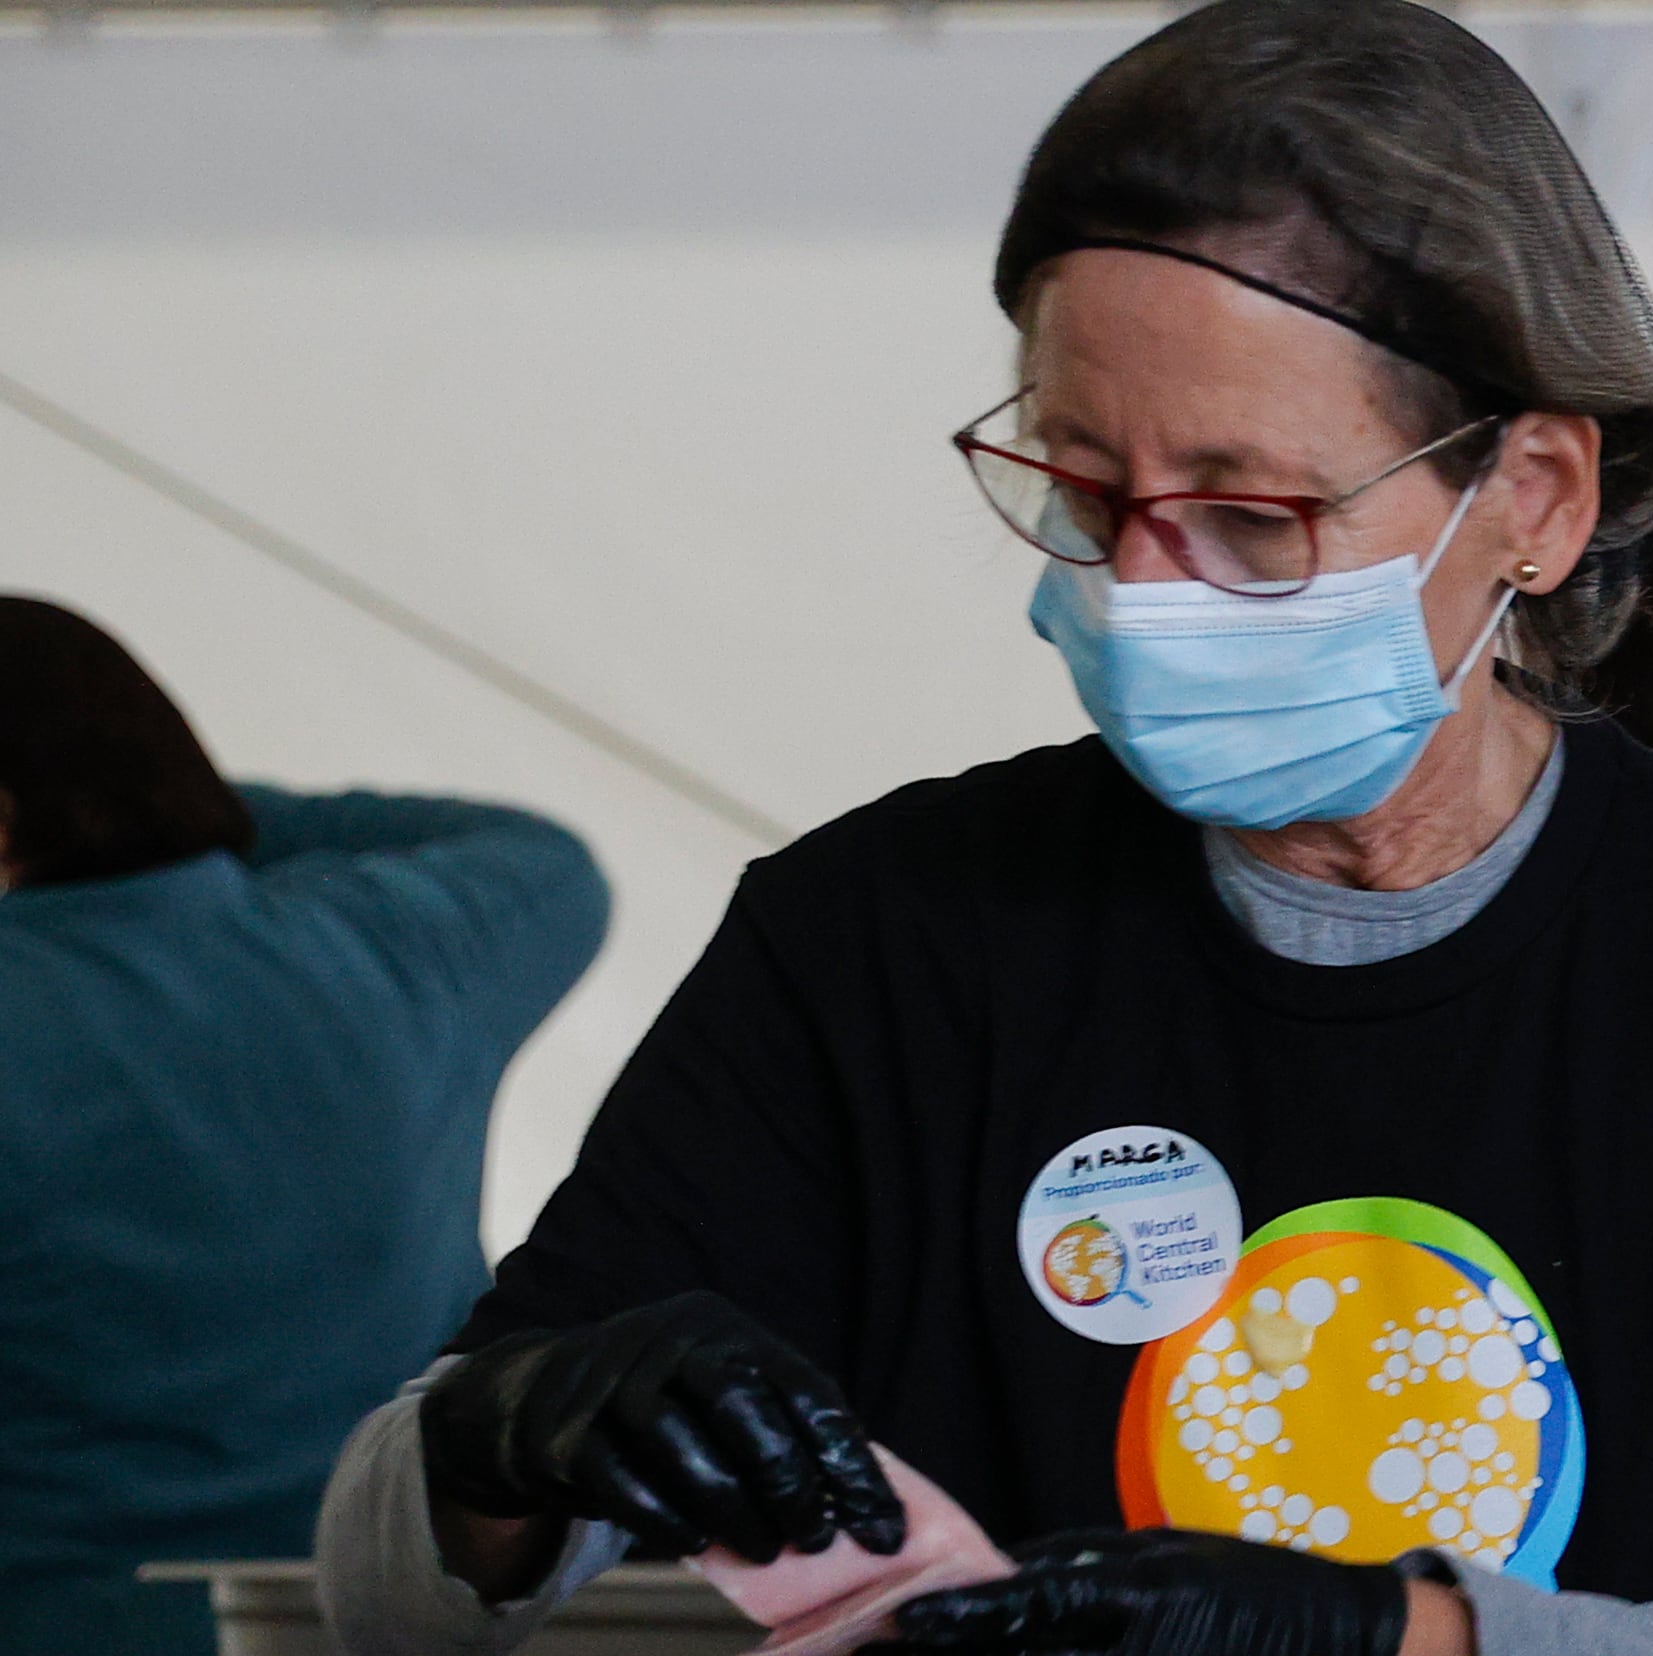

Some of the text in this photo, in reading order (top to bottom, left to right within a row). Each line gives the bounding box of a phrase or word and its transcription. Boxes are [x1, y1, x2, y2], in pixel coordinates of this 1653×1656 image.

[1070, 1140, 1185, 1177] MARGA
[1132, 1211, 1198, 1240] World
[1137, 1231, 1218, 1263] Central
[1141, 1257, 1227, 1285] Kitchen
